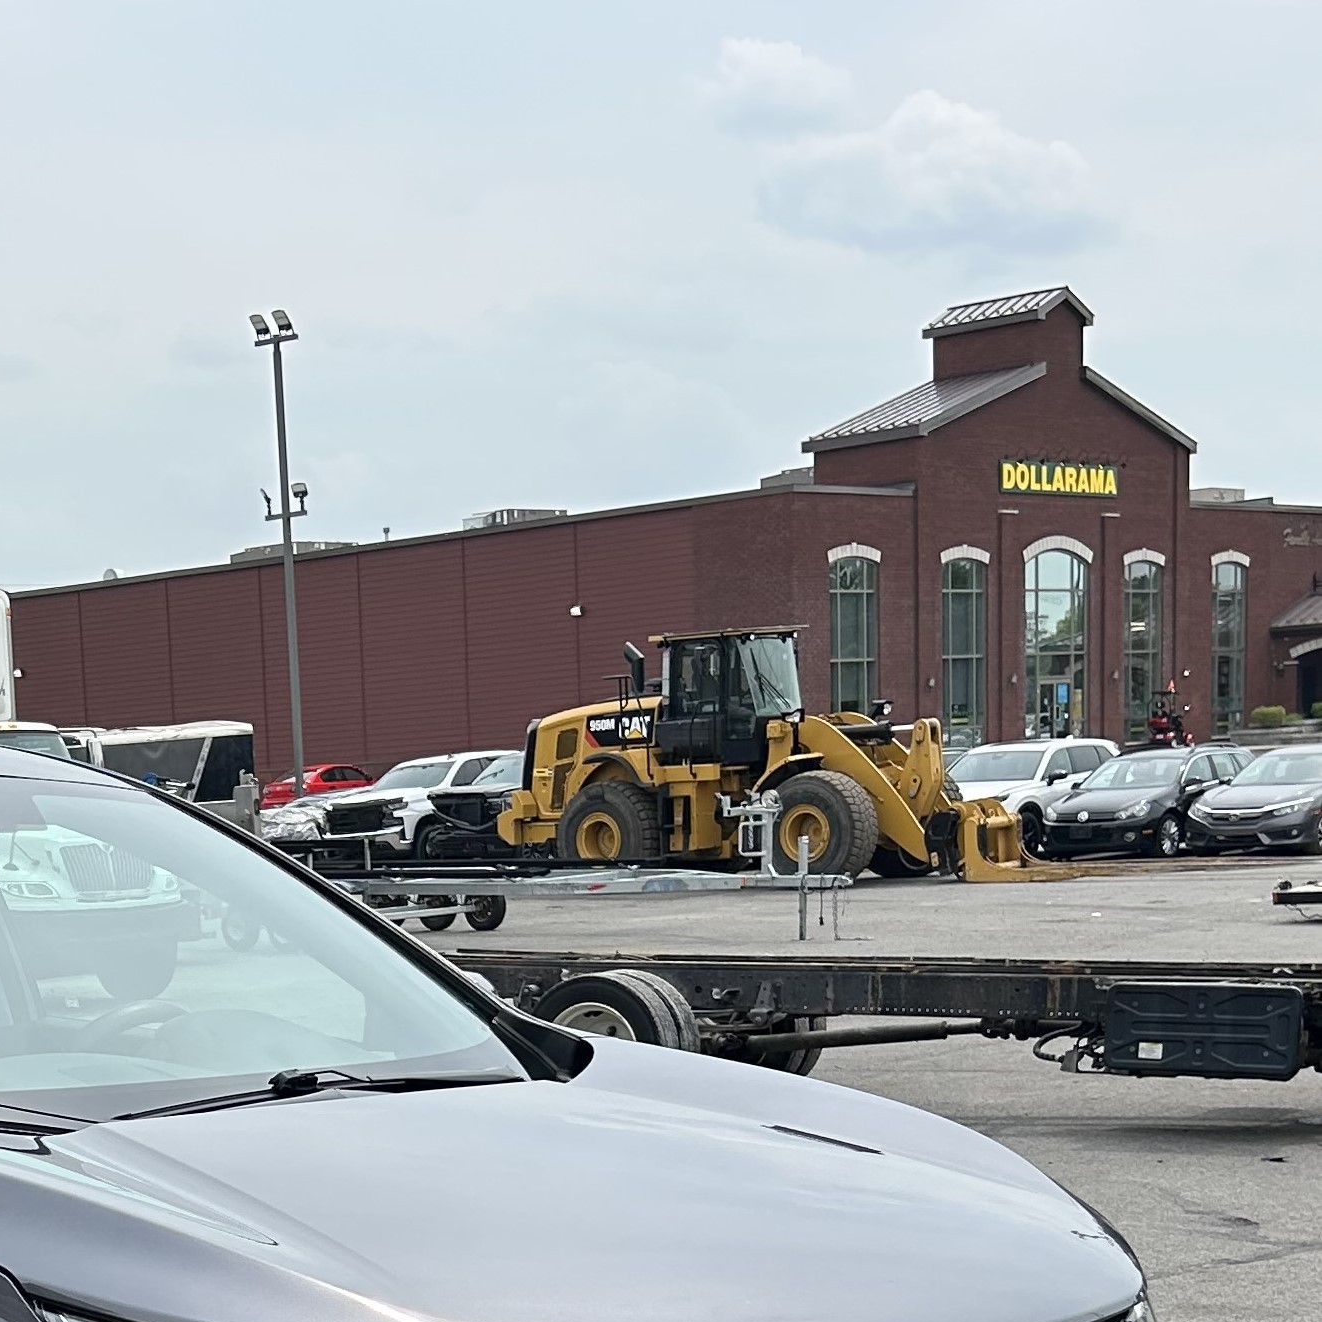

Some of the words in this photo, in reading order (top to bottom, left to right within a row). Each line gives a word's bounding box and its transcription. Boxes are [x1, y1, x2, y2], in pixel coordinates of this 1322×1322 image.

[1002, 463, 1118, 495] DOLLARAMA
[589, 718, 616, 732] 950M
[619, 715, 651, 740] CAT
